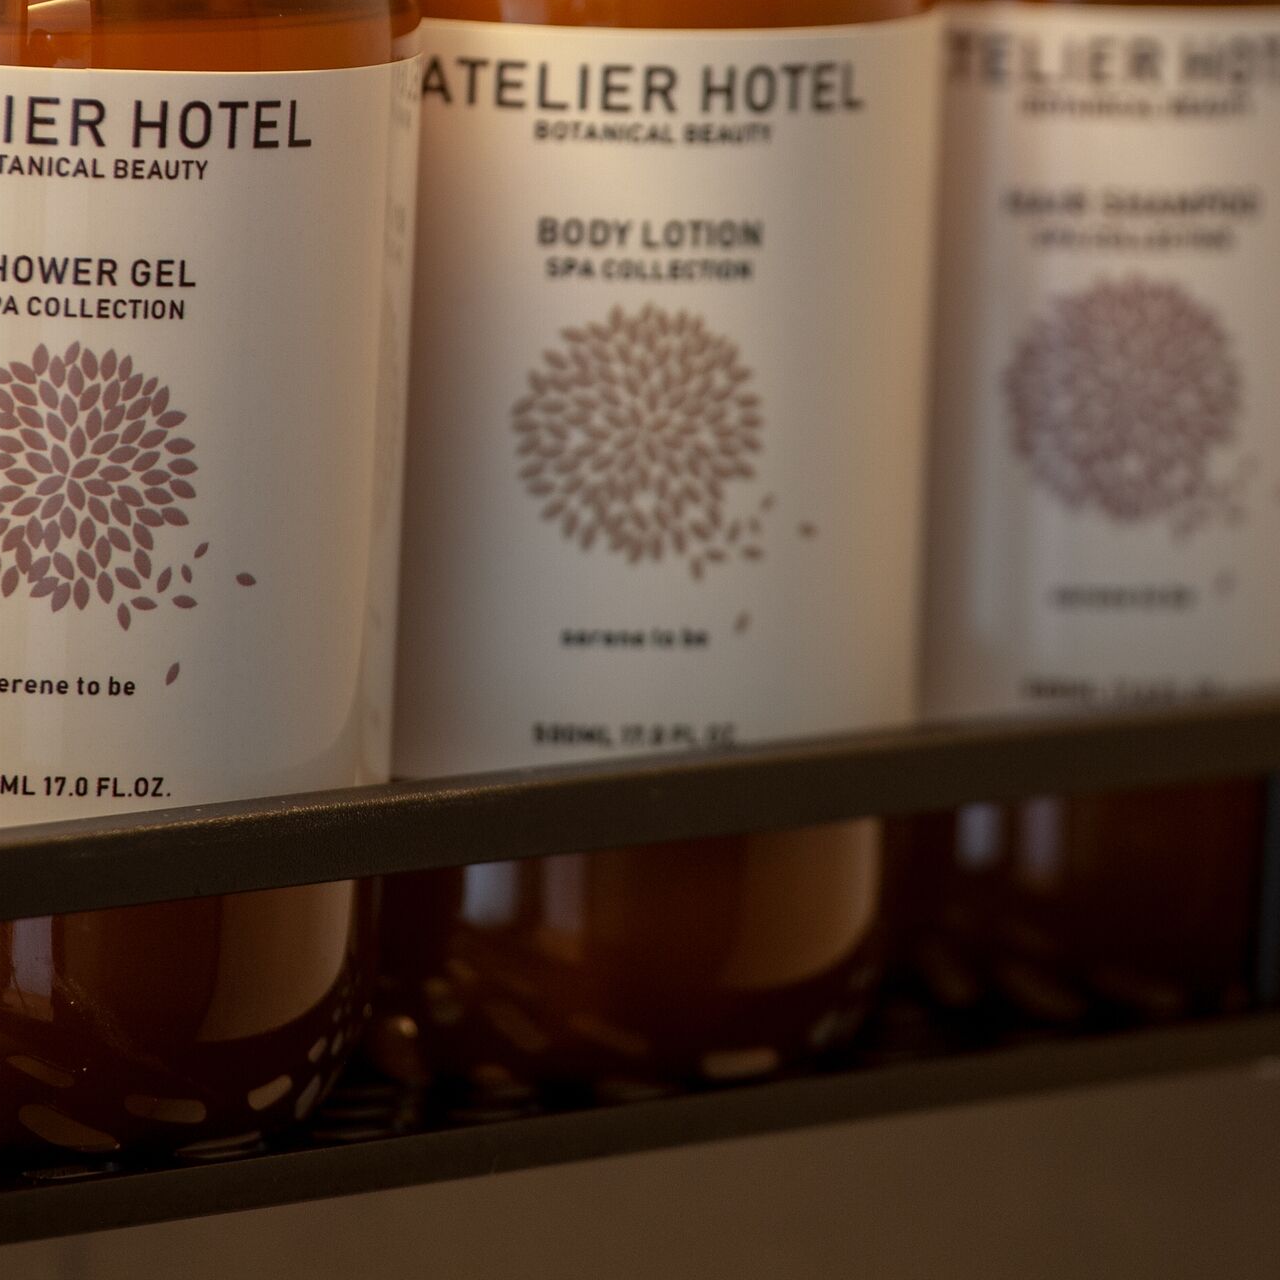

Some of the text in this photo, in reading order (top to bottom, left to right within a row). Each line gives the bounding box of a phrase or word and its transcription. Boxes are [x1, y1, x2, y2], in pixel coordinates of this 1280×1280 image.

[421, 56, 677, 114] ATELIER
[700, 61, 865, 116] HOTEL
[132, 99, 312, 150] HOTEL
[533, 119, 771, 146] BOTANICAL BEAUTY
[113, 158, 209, 181] BEAUTY
[536, 216, 763, 252] BODY LOTION
[130, 258, 196, 288] GEL
[546, 257, 754, 283] SPA COLLECTION
[26, 295, 185, 320] COLLECTION
[76, 676, 100, 696] to
[108, 676, 136, 697] be
[43, 775, 89, 798] 17.0
[96, 776, 171, 798] FL.OZ.
